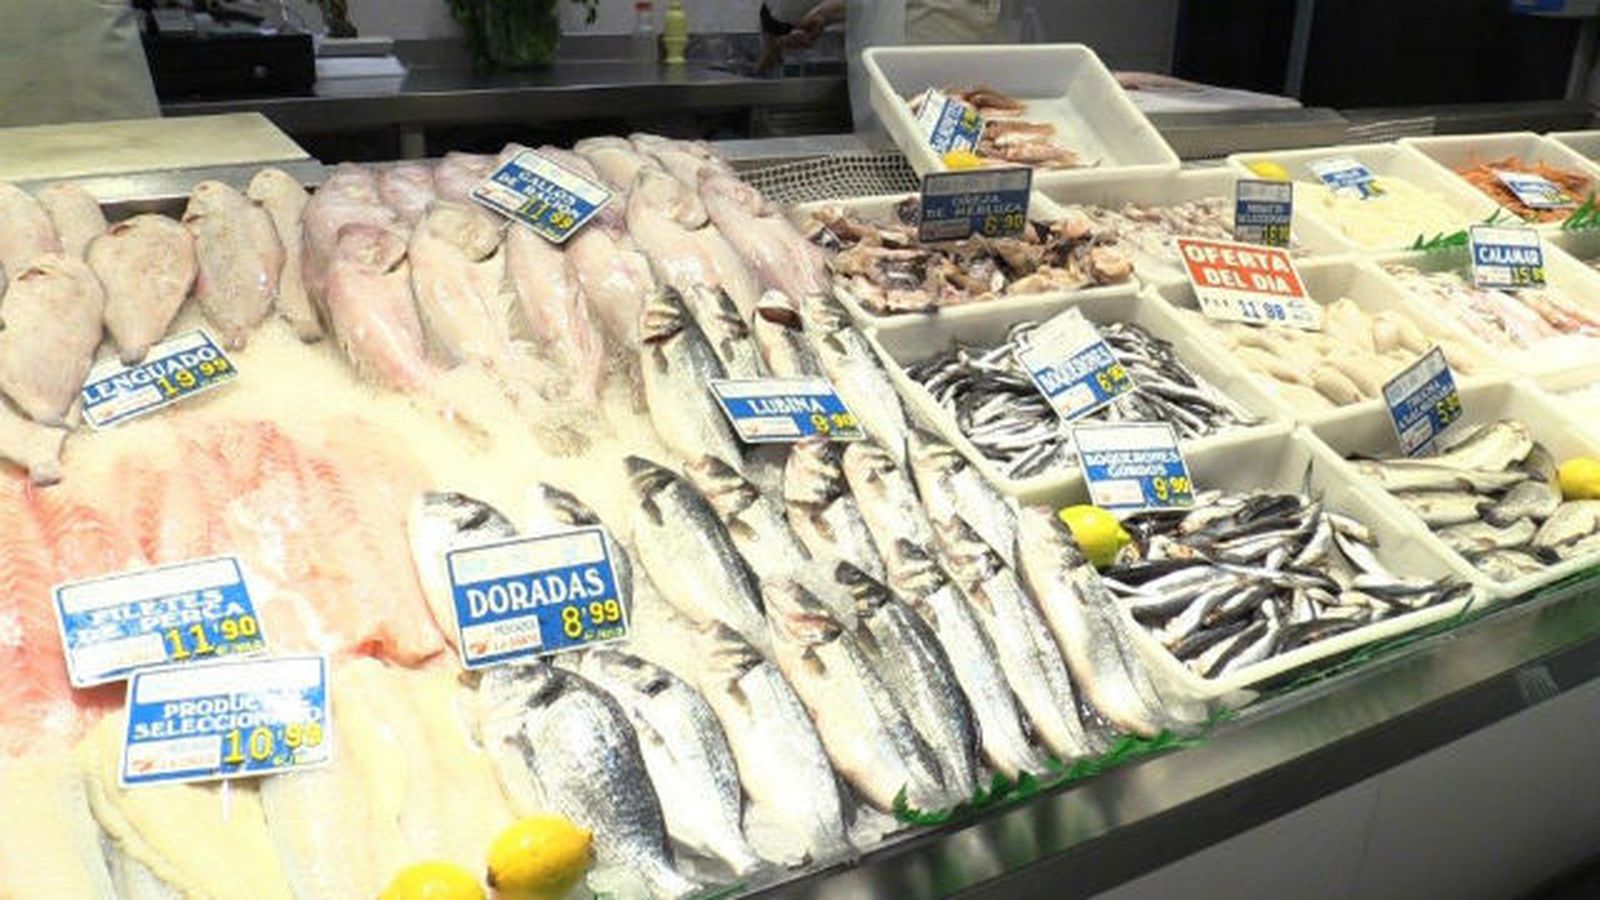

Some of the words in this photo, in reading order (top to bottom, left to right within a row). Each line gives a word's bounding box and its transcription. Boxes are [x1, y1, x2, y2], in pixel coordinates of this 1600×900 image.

[519, 171, 575, 205] GALLOS
[1184, 245, 1291, 273] OFERTA
[1479, 246, 1540, 264] CALAMAR
[1202, 267, 1250, 289] DEL
[81, 346, 217, 404] LENGUADO
[747, 397, 827, 414] LUBINA
[466, 568, 605, 617] DORADAS
[142, 601, 245, 630] PERCA
[562, 599, 620, 639] 8'99
